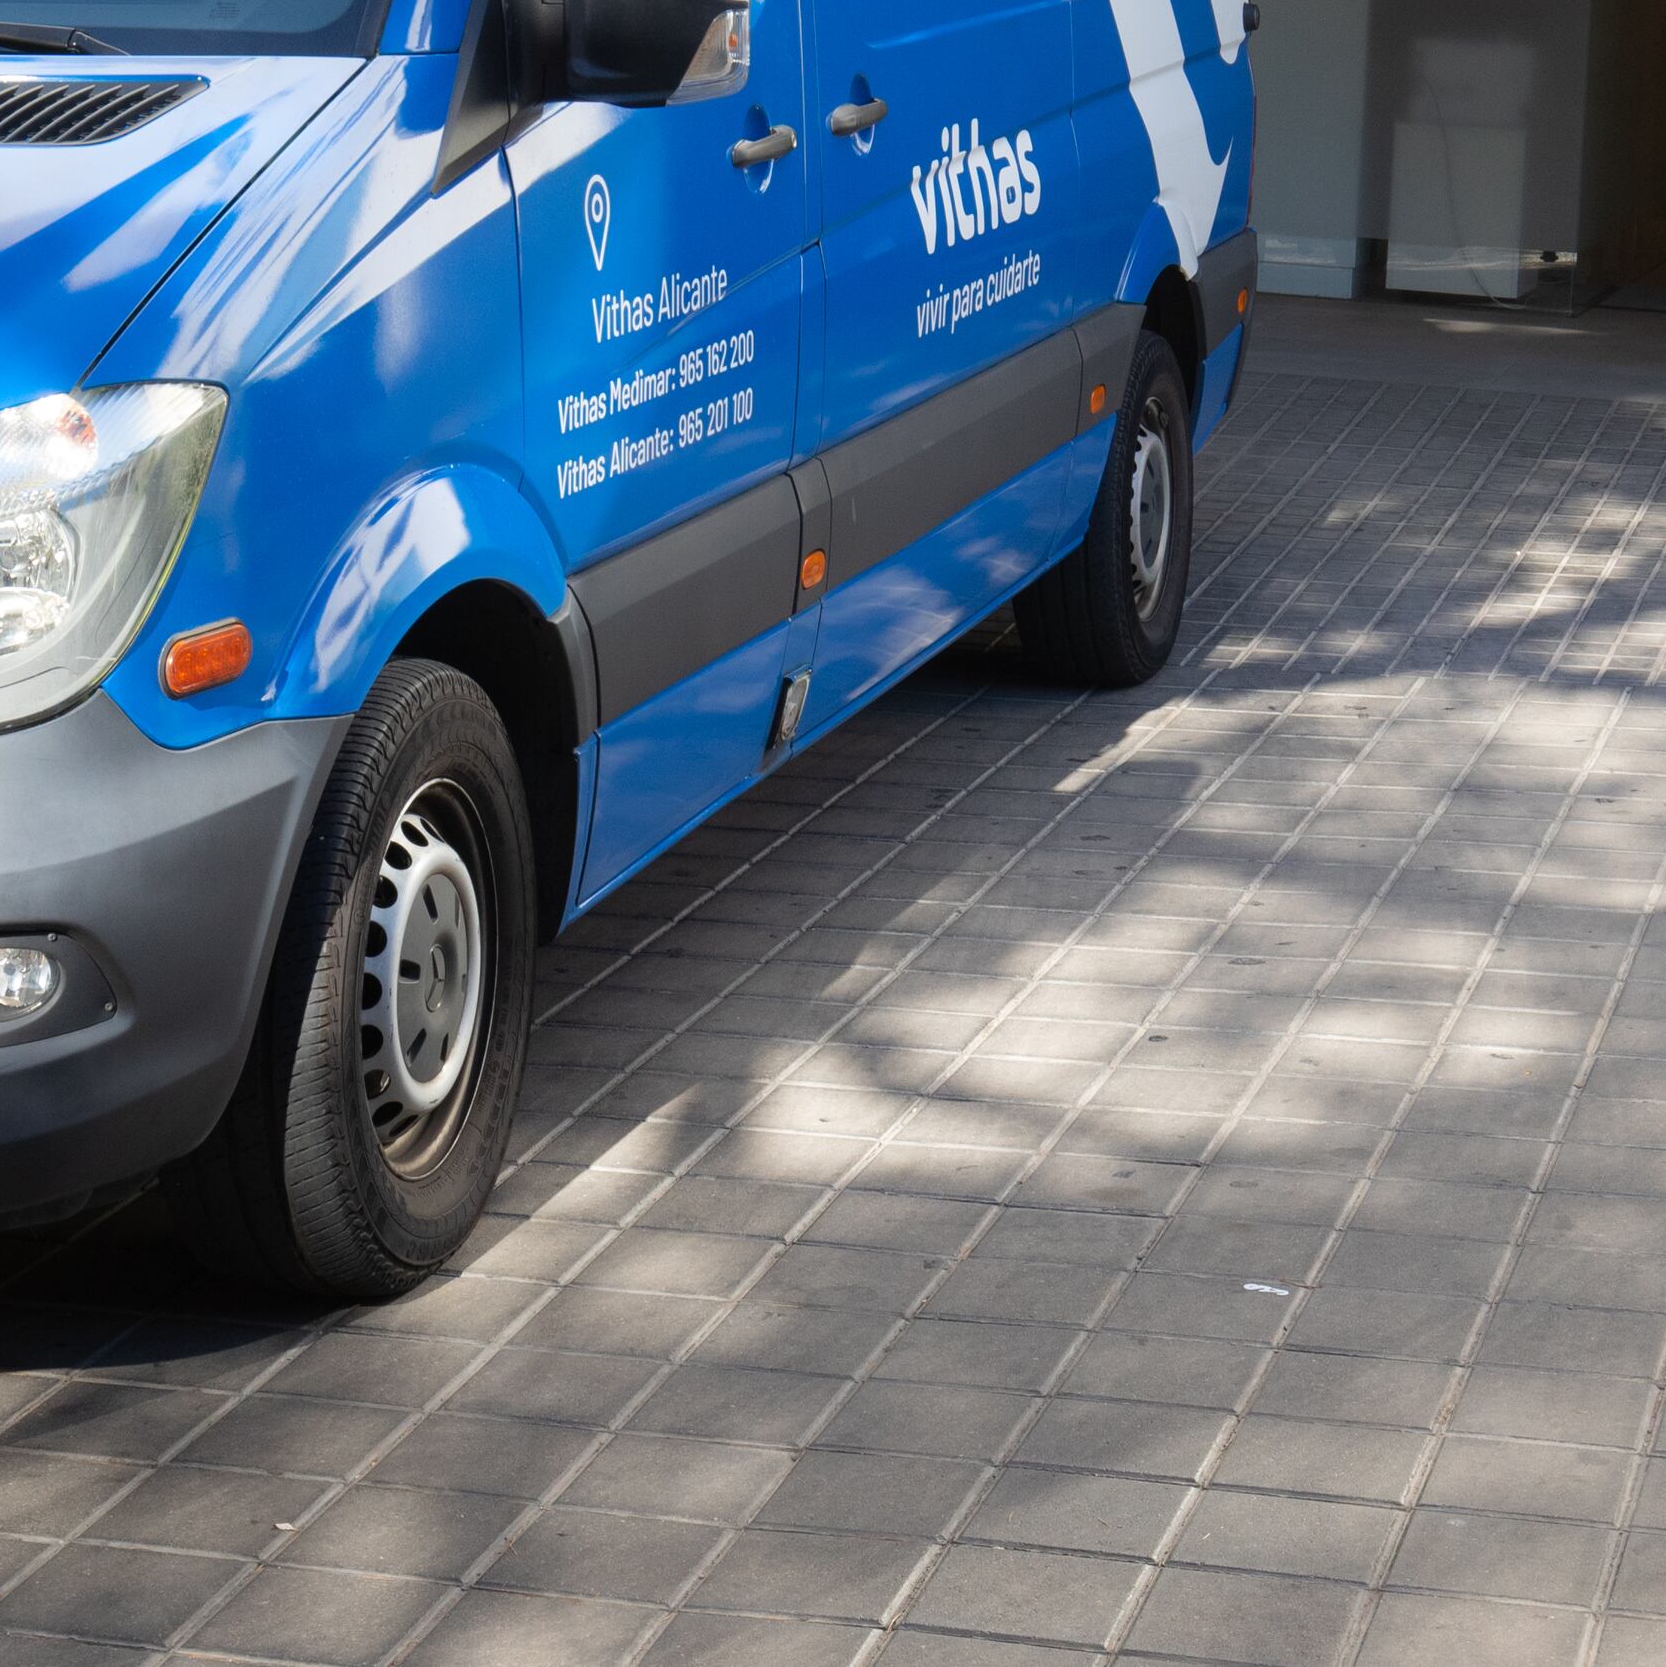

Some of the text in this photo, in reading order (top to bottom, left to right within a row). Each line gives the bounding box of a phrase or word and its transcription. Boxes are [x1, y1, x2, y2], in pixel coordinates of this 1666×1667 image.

[911, 117, 1041, 255] vithas
[591, 264, 728, 343] Vithas Alicante
[917, 249, 1041, 338] vivir para cuidarte
[557, 330, 754, 434] Vithas Medimar: 965 162 200
[556, 387, 753, 499] Vithas Alicante: 965 201 100
